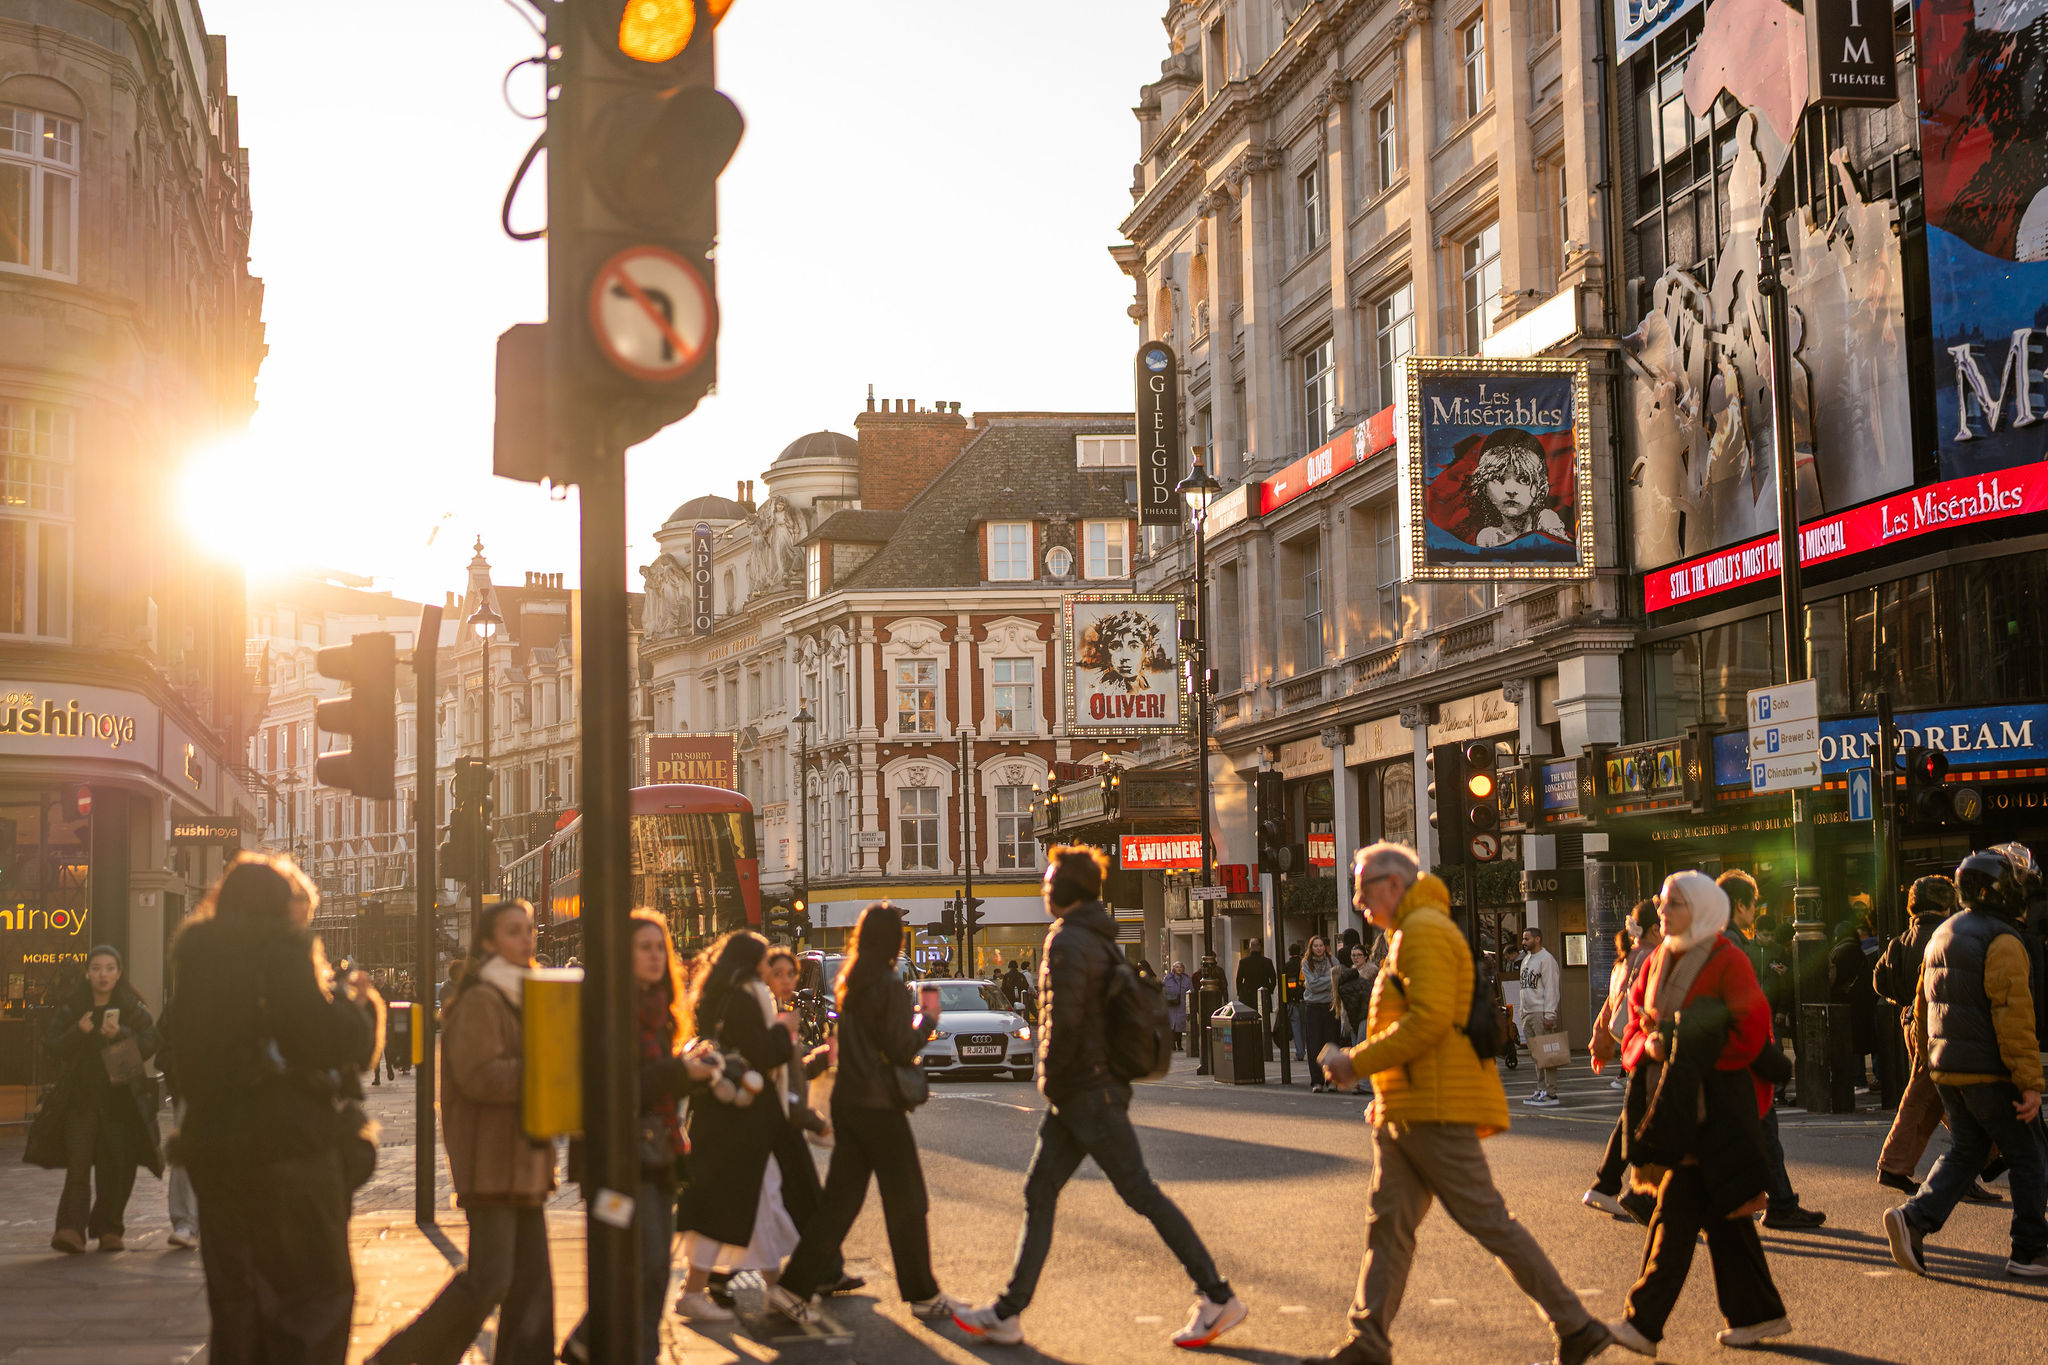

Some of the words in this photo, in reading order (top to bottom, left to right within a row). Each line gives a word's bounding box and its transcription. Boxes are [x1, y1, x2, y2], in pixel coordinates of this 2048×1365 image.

[1830, 73, 1886, 85] THEATRE
[1947, 327, 2048, 441] M
[1478, 383, 1510, 405] Les
[1430, 396, 1562, 426] Misérables
[1149, 375, 1169, 504] GIELGUD
[1881, 504, 1908, 539] Les
[1911, 477, 2023, 530] Misérables
[1670, 569, 1690, 600] STILL
[1690, 563, 1705, 592] THE
[1706, 552, 1741, 587] WORLD'S
[1742, 544, 1765, 578] MOST
[1804, 520, 1846, 559] MUSICAL
[696, 538, 711, 630] APOLLO
[707, 645, 729, 662] APOLLO
[731, 632, 758, 654] THEATRE
[1089, 692, 1166, 720] OLIVER!
[1772, 700, 1789, 710] Soho
[1781, 733, 1804, 744] Brewer
[1806, 729, 1815, 740] St
[1896, 719, 2035, 755] DREAM
[671, 752, 683, 760] I'M
[684, 752, 712, 760] SORRY
[657, 760, 728, 780] PRIME
[1550, 773, 1560, 783] THE
[1767, 767, 1802, 779] Chinatown
[1544, 781, 1566, 793] LONGEST
[174, 824, 239, 839] sushinoya
[1783, 816, 1793, 828] AN
[666, 849, 687, 868] 14
[23, 953, 56, 964] MORE
